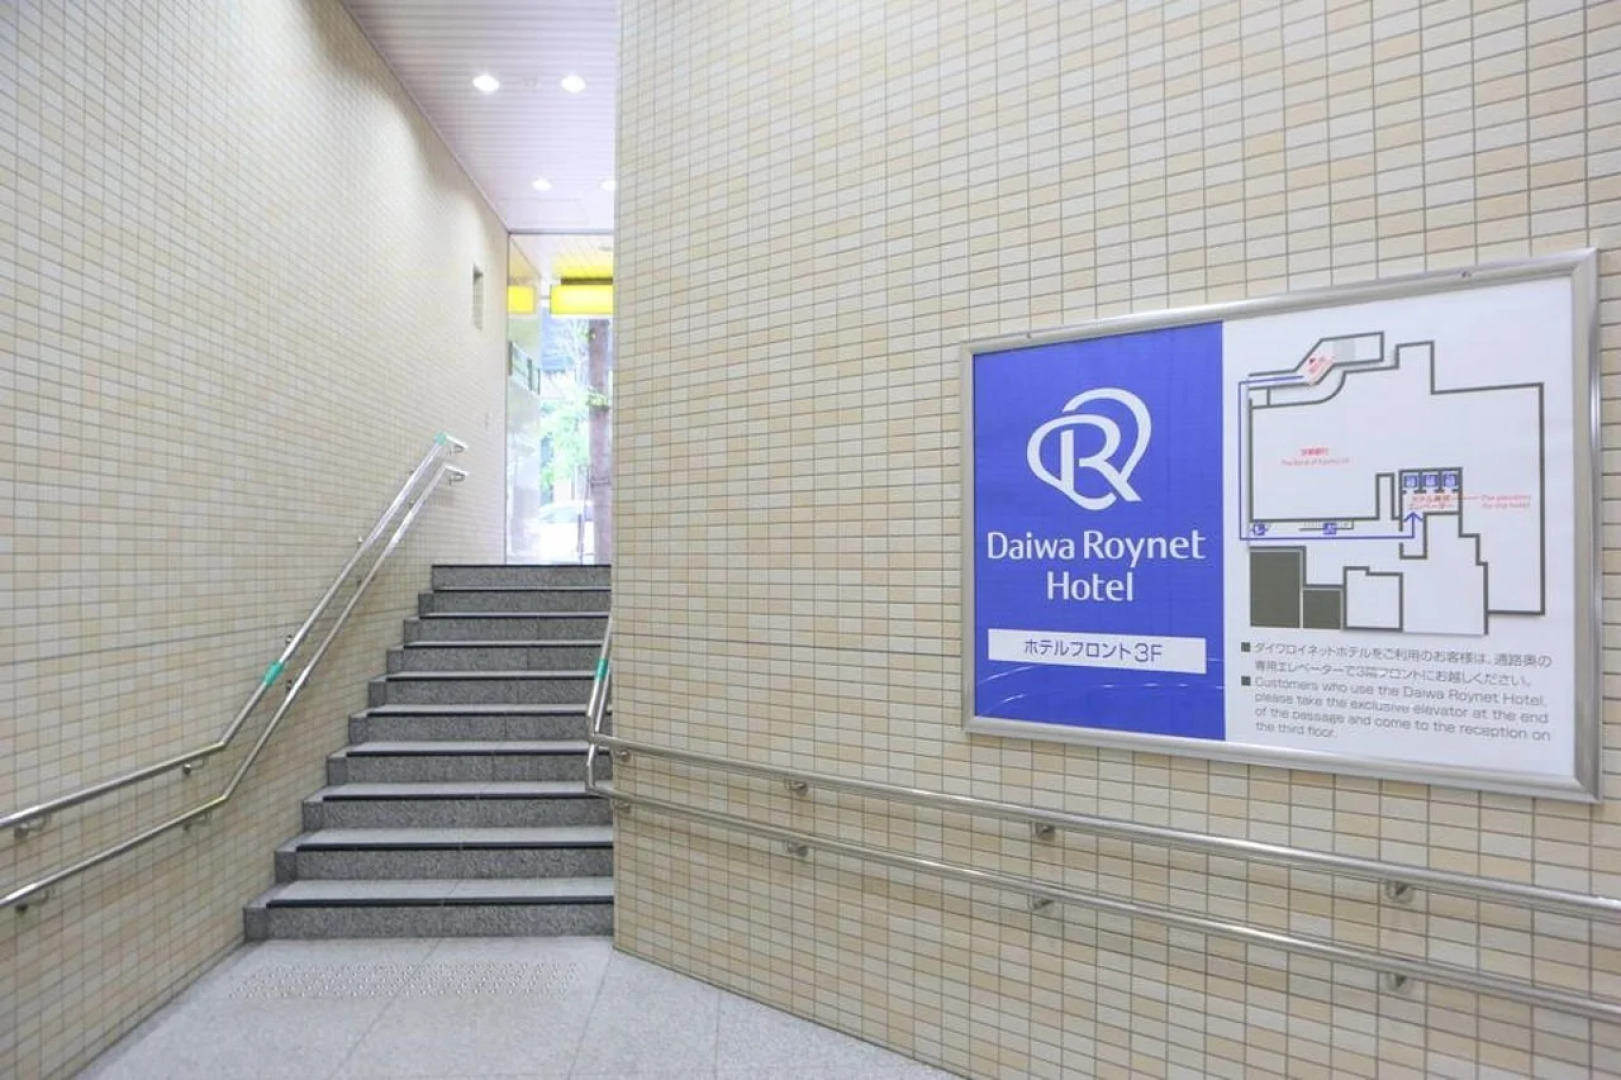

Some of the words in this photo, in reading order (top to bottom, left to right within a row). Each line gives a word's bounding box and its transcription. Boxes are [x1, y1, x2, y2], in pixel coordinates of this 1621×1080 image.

[987, 531, 1075, 560] Daiwa
[1083, 529, 1207, 568] Roynet
[1047, 570, 1134, 602] Hotel
[1024, 639, 1163, 663] ホテルフロント3F
[1255, 676, 1319, 691] Customers
[1322, 682, 1347, 694] who
[1351, 685, 1374, 695] use
[1378, 685, 1399, 697] the
[1403, 686, 1445, 700] Daiwa
[1449, 689, 1499, 704] Roynet
[1255, 692, 1294, 706] please
[1297, 694, 1323, 706] take
[1327, 697, 1347, 708] the
[1350, 699, 1409, 713] exclusive
[1413, 704, 1468, 718] elevator
[1473, 709, 1491, 720] at
[1493, 709, 1516, 722] the
[1520, 711, 1549, 724] end
[1255, 707, 1267, 717] of
[1271, 708, 1289, 719] the
[1293, 710, 1345, 725] passage
[1348, 714, 1371, 727] and
[1374, 717, 1411, 730] come
[1415, 719, 1429, 731] to
[1434, 720, 1456, 734] the
[1459, 724, 1527, 740] reception
[1532, 730, 1551, 742] on
[1256, 722, 1275, 733] the
[1278, 723, 1304, 735] third
